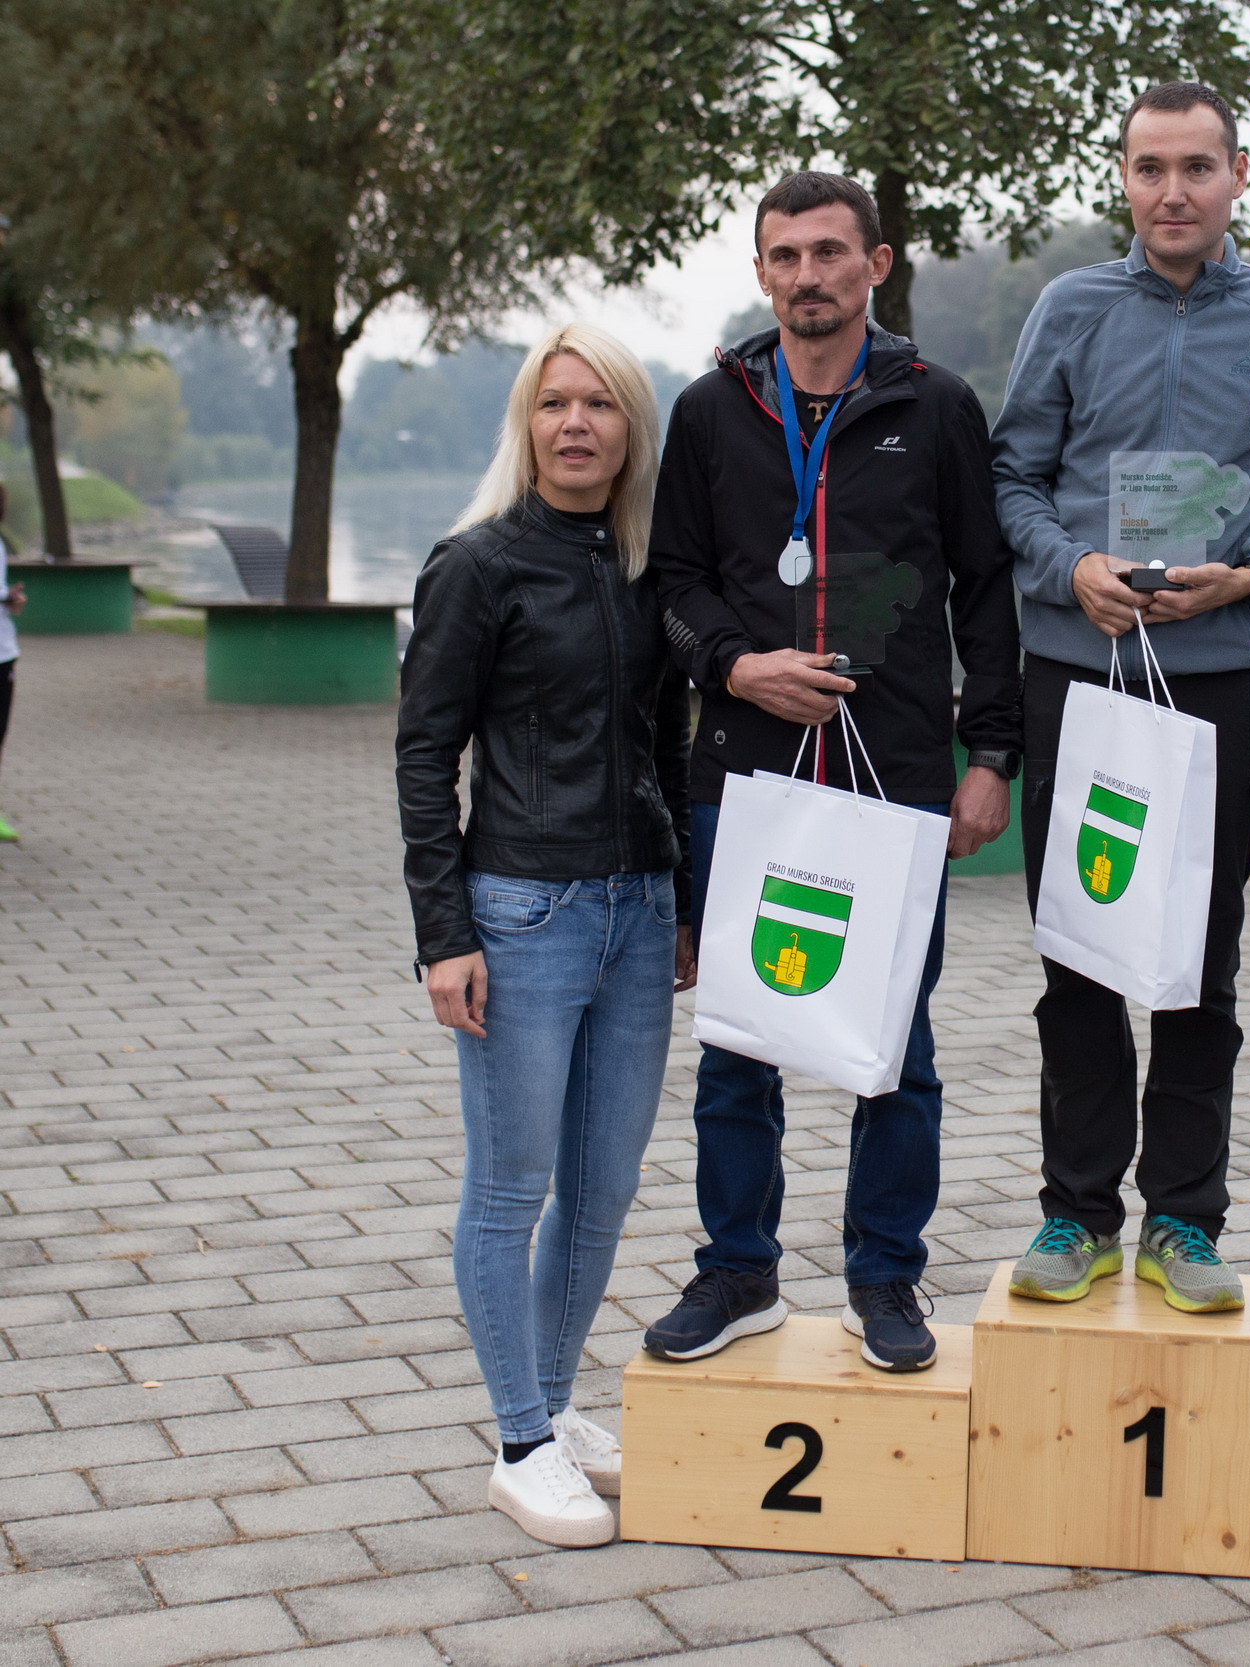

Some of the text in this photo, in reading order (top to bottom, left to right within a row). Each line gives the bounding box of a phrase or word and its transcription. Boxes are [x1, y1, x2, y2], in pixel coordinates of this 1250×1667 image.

[1120, 473, 1144, 481] Mursko
[1120, 484, 1179, 492] IV. Liga Rudar 2022.
[1120, 502, 1129, 515] 1.
[1120, 517, 1149, 528] mjesto
[1093, 770, 1152, 801] GRAD MURSKO SREDIŠĆE
[766, 861, 856, 893] GRAD MURSKO SREDIŠĆE
[1124, 1407, 1165, 1497] 1
[761, 1422, 823, 1513] 2
